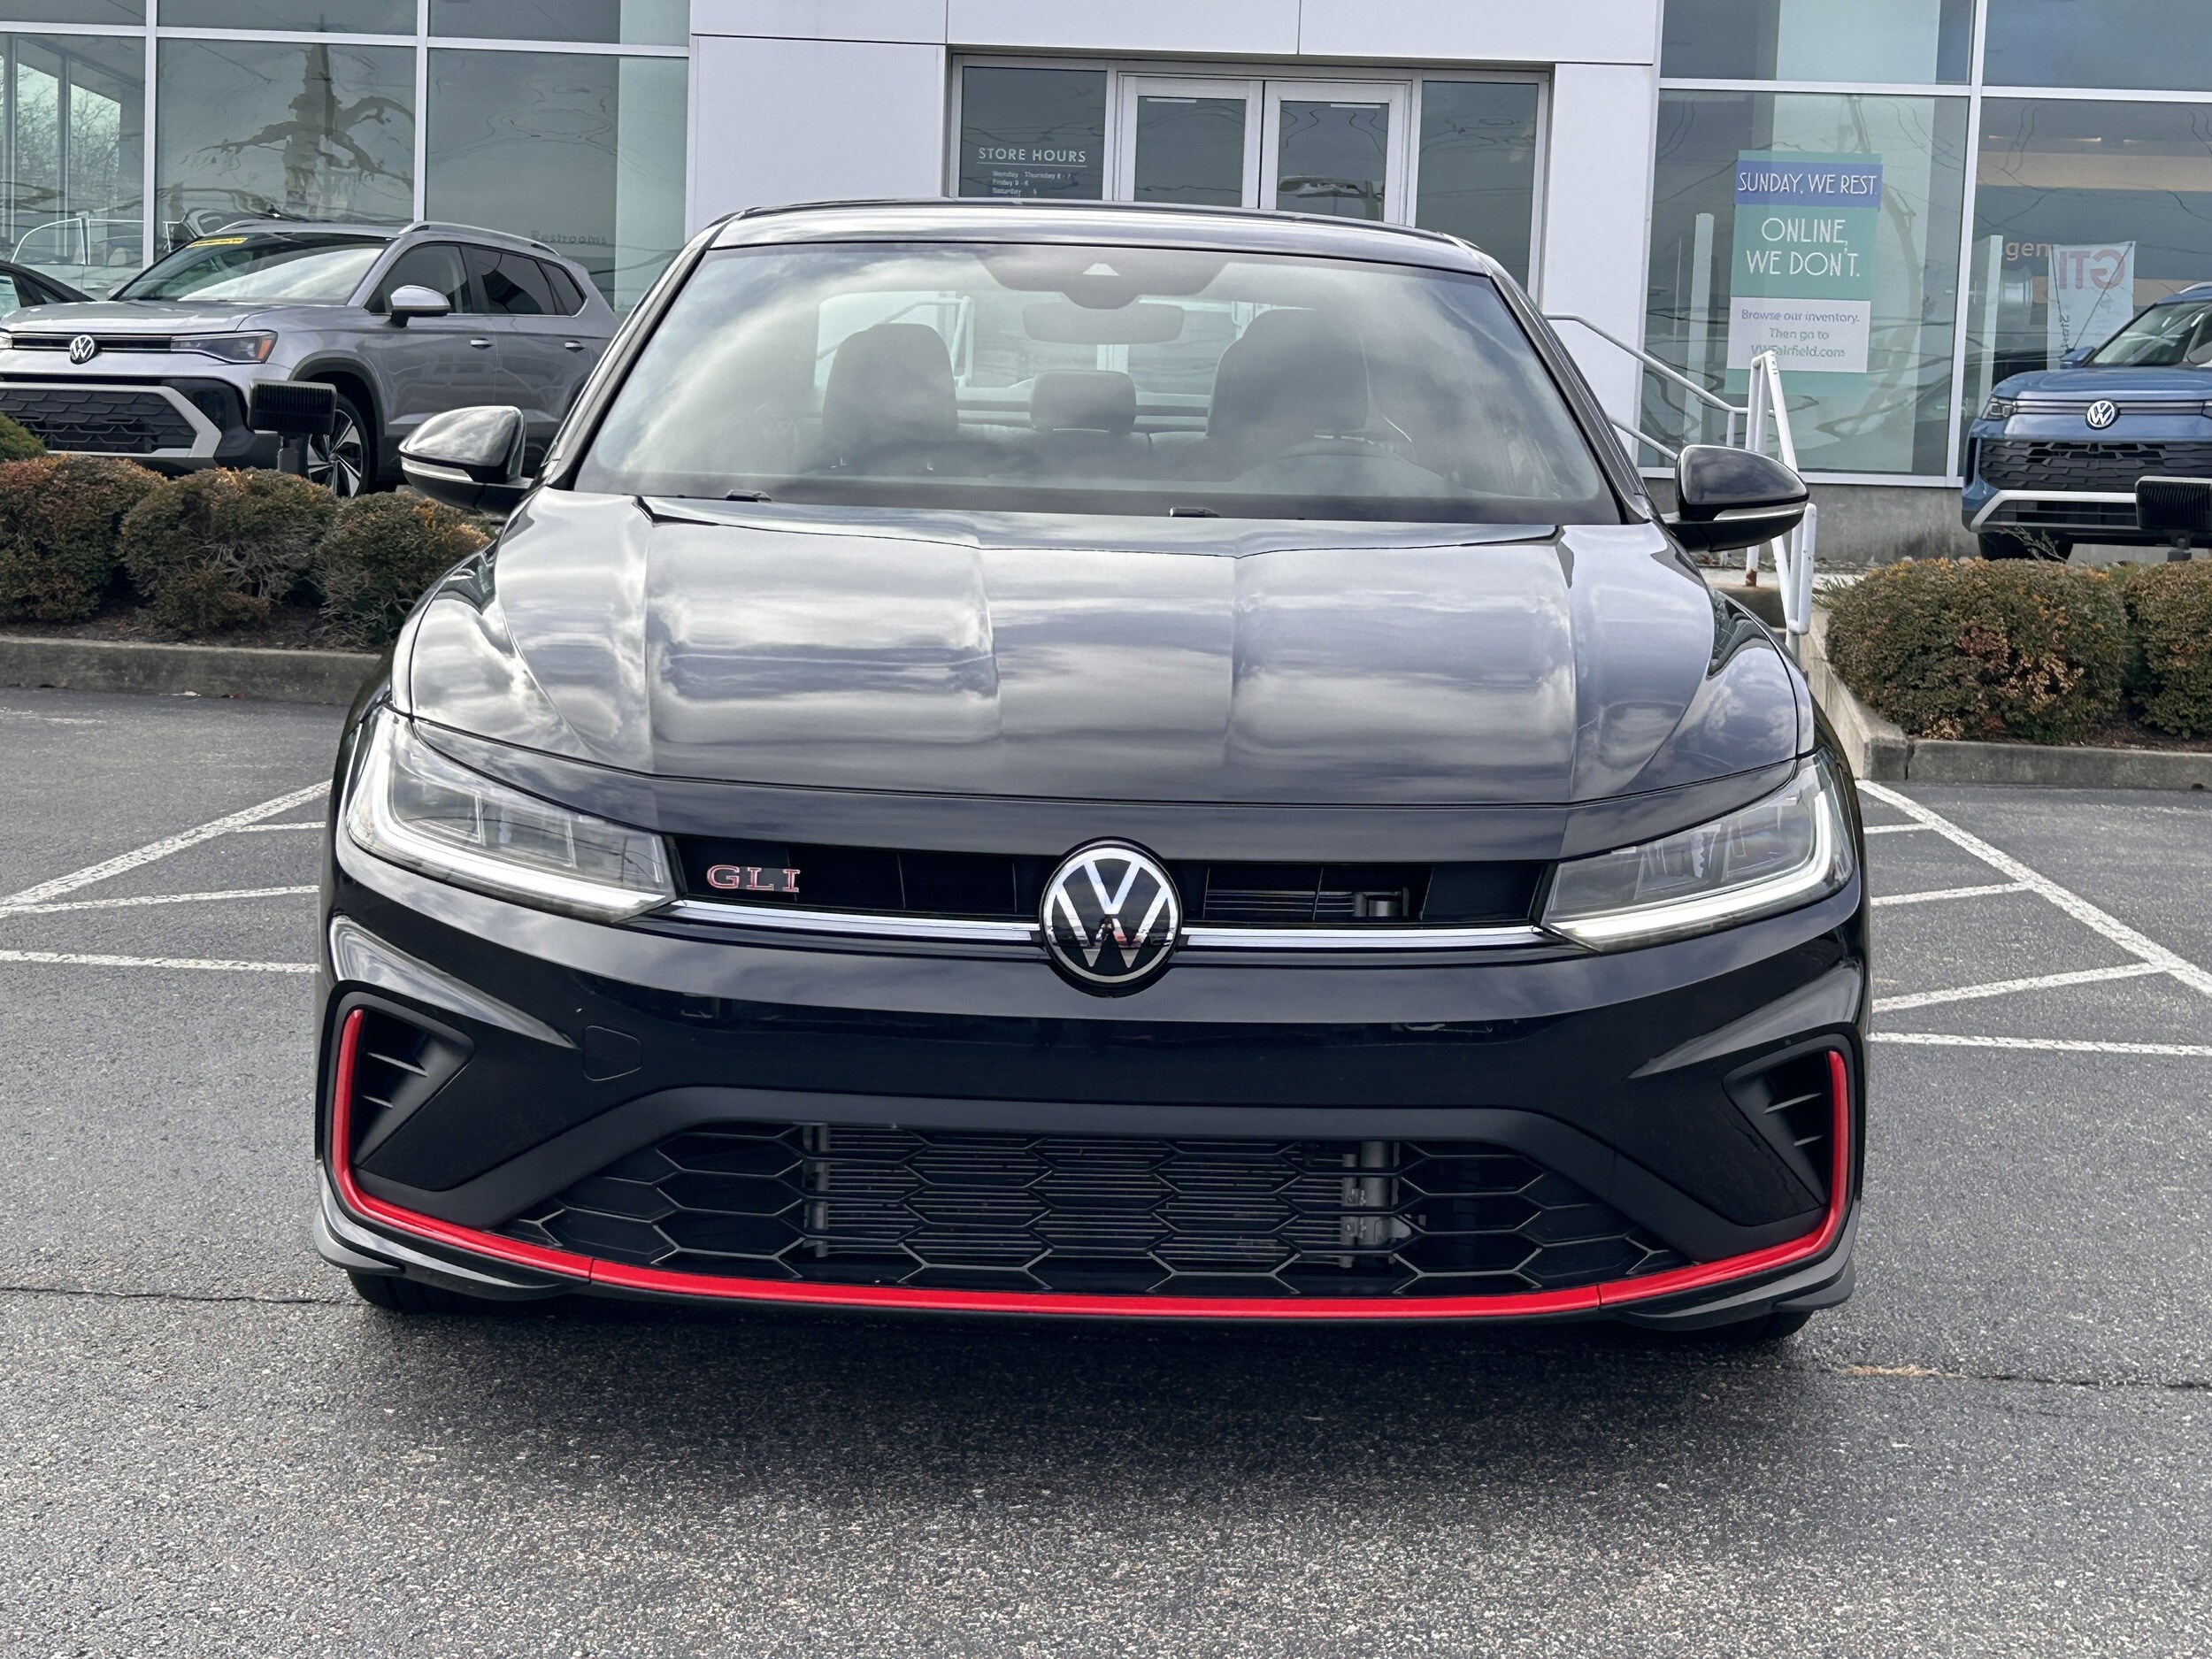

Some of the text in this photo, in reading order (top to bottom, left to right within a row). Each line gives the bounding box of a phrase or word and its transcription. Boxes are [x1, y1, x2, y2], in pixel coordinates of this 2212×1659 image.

[978, 147, 1086, 163] STORE HOURS
[1808, 173, 1836, 194] WE
[531, 230, 607, 245] Restrooms
[1762, 218, 1848, 247] ONLINE,
[1747, 247, 1861, 278] WE DON'T.
[1741, 309, 1860, 326] Browse our inventory.
[1770, 327, 1830, 342] Then go to
[707, 864, 801, 893] GLI
